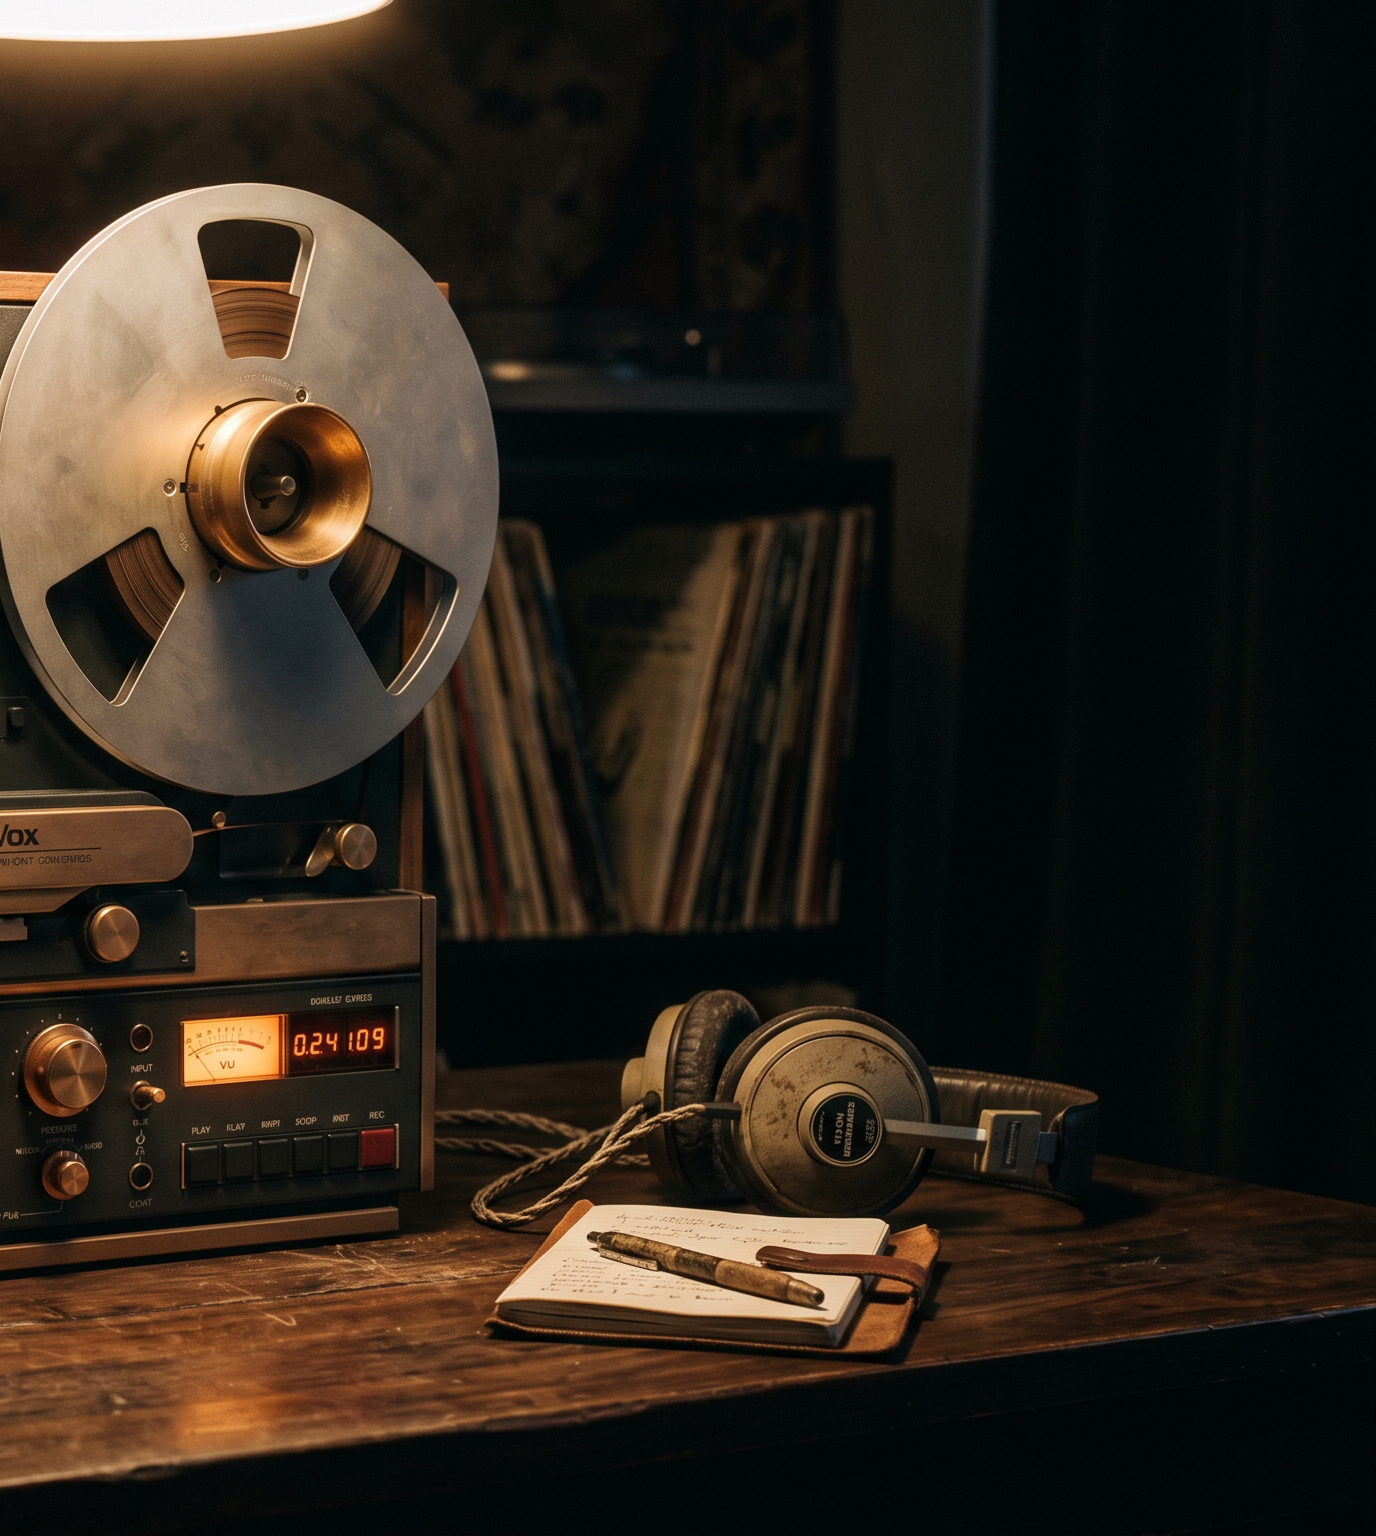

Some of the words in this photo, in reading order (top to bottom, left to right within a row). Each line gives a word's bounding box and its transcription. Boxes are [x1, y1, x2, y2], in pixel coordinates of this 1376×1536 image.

[220, 1060, 235, 1070] VU
[369, 1110, 385, 1120] REC
[191, 1125, 211, 1135] PLAY
[129, 1199, 152, 1209] COAT
